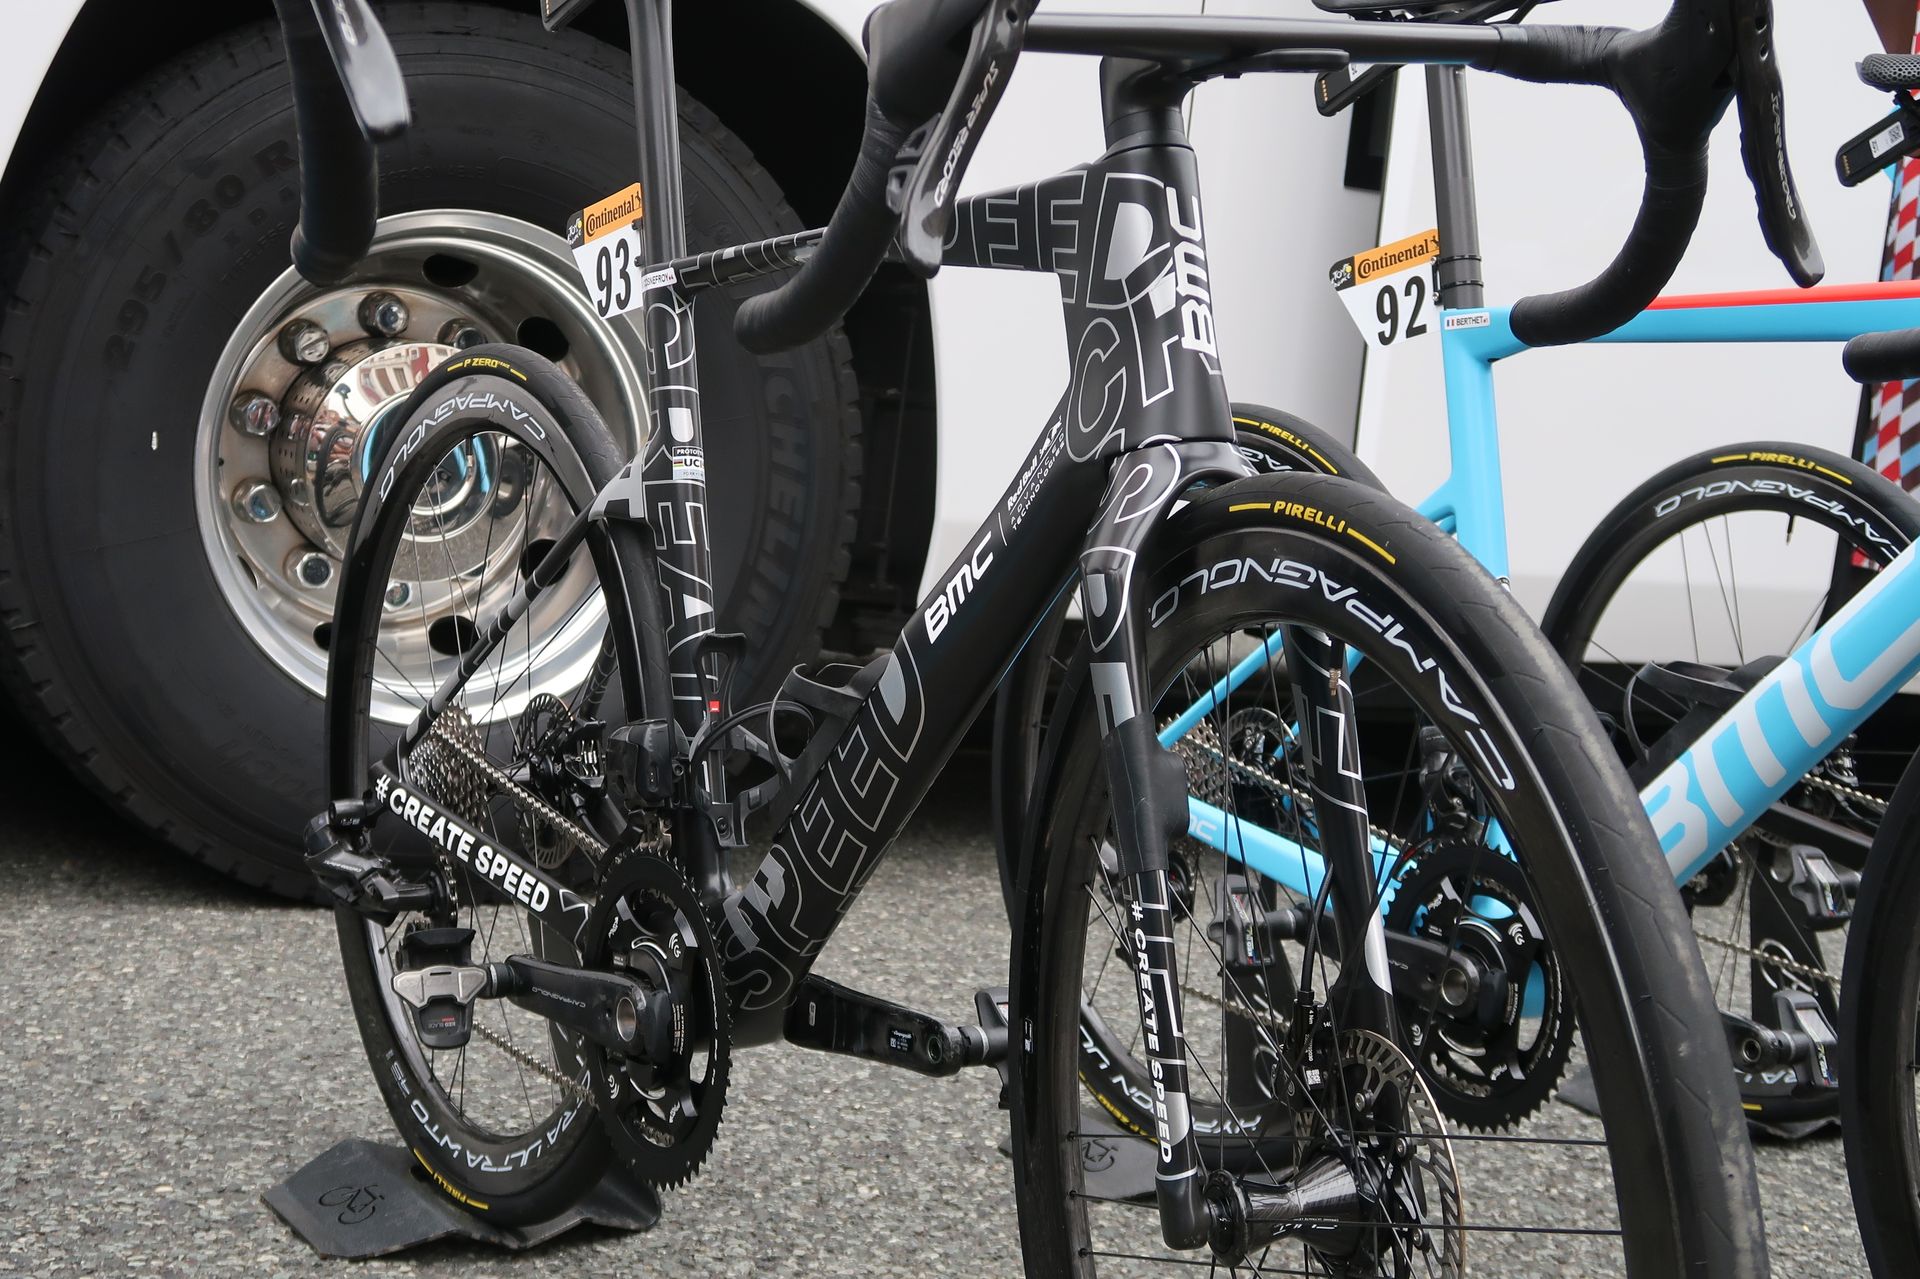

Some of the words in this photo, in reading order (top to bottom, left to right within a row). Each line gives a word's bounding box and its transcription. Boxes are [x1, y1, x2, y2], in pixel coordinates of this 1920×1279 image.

[586, 194, 635, 237] Continental
[597, 238, 631, 318] 93
[1166, 186, 1218, 359] BMC
[1357, 239, 1430, 279] Continental
[1376, 275, 1427, 346] 92
[1456, 316, 1483, 326] BERTHET
[463, 358, 472, 368] P
[472, 357, 499, 368] ZERO
[379, 392, 546, 503] CAMPAGNOLO
[1259, 422, 1309, 451] PIRELLI
[1748, 452, 1816, 470] PIRELLI
[1273, 500, 1346, 533] PIRELLI
[924, 531, 994, 645] BMC
[1151, 556, 1516, 791] CAMPAGNOLO
[1638, 538, 1920, 878] BMC
[390, 788, 475, 863] CREATE
[475, 845, 550, 913] SPEED
[531, 986, 586, 1008] CAMPAGNOLO
[1135, 927, 1159, 1053] CREATE
[1151, 1058, 1172, 1164] SPEED
[411, 1099, 462, 1159] WTO
[466, 1139, 543, 1172] ULTRA
[433, 1172, 467, 1203] PIRELLI
